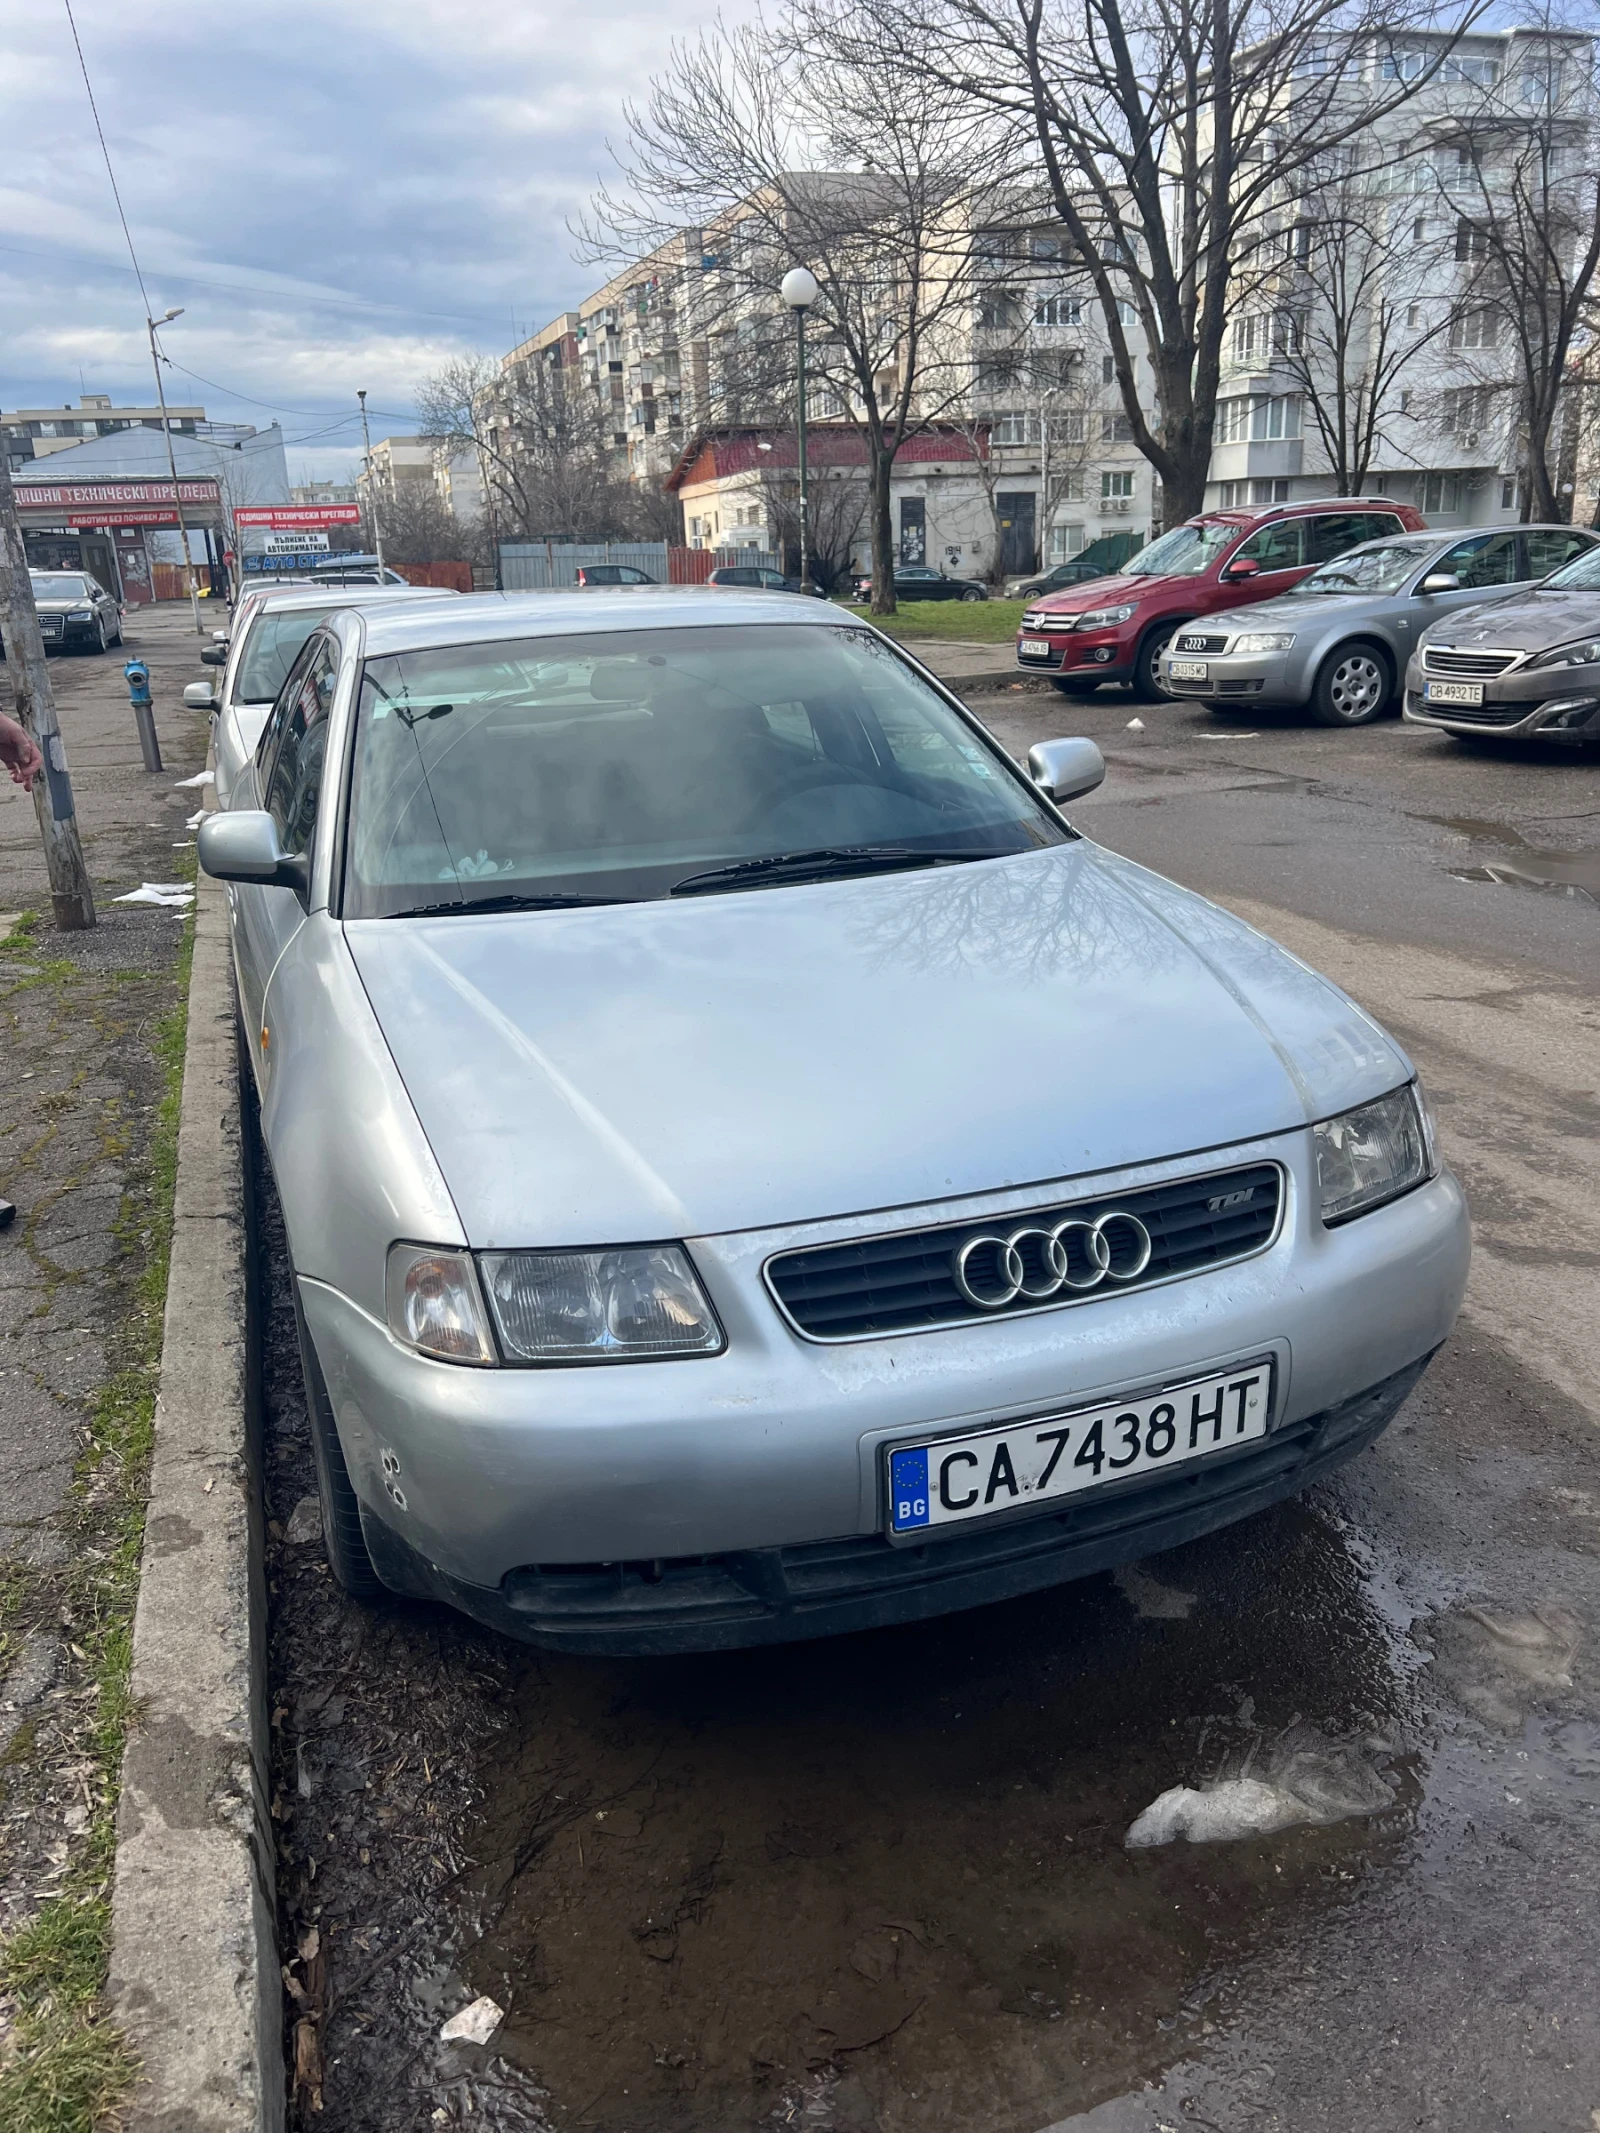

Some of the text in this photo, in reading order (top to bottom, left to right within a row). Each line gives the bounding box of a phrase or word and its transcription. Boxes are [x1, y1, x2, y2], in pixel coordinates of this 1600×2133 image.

[14, 488, 62, 505] ДИШНИ
[65, 486, 149, 502] ТЕХНИЧЕСКИ
[72, 512, 173, 525] РАБОТИМ БЕЗ ПОЧИВЕН ДЕН
[237, 510, 356, 522] ГОДИШНИ ТЕХНИЧЕСКИ ПРЕГЛЕДИ
[274, 536, 306, 544] ПЪЛНЕНЕ
[267, 543, 328, 553] АВТОКЛИМАТИЦИ
[262, 556, 295, 570] АУТО
[1430, 685, 1481, 701] CB 4932 TE
[1208, 1187, 1255, 1212] TDI
[939, 1375, 1260, 1511] CA 7438 HT
[898, 1498, 926, 1520] BG
